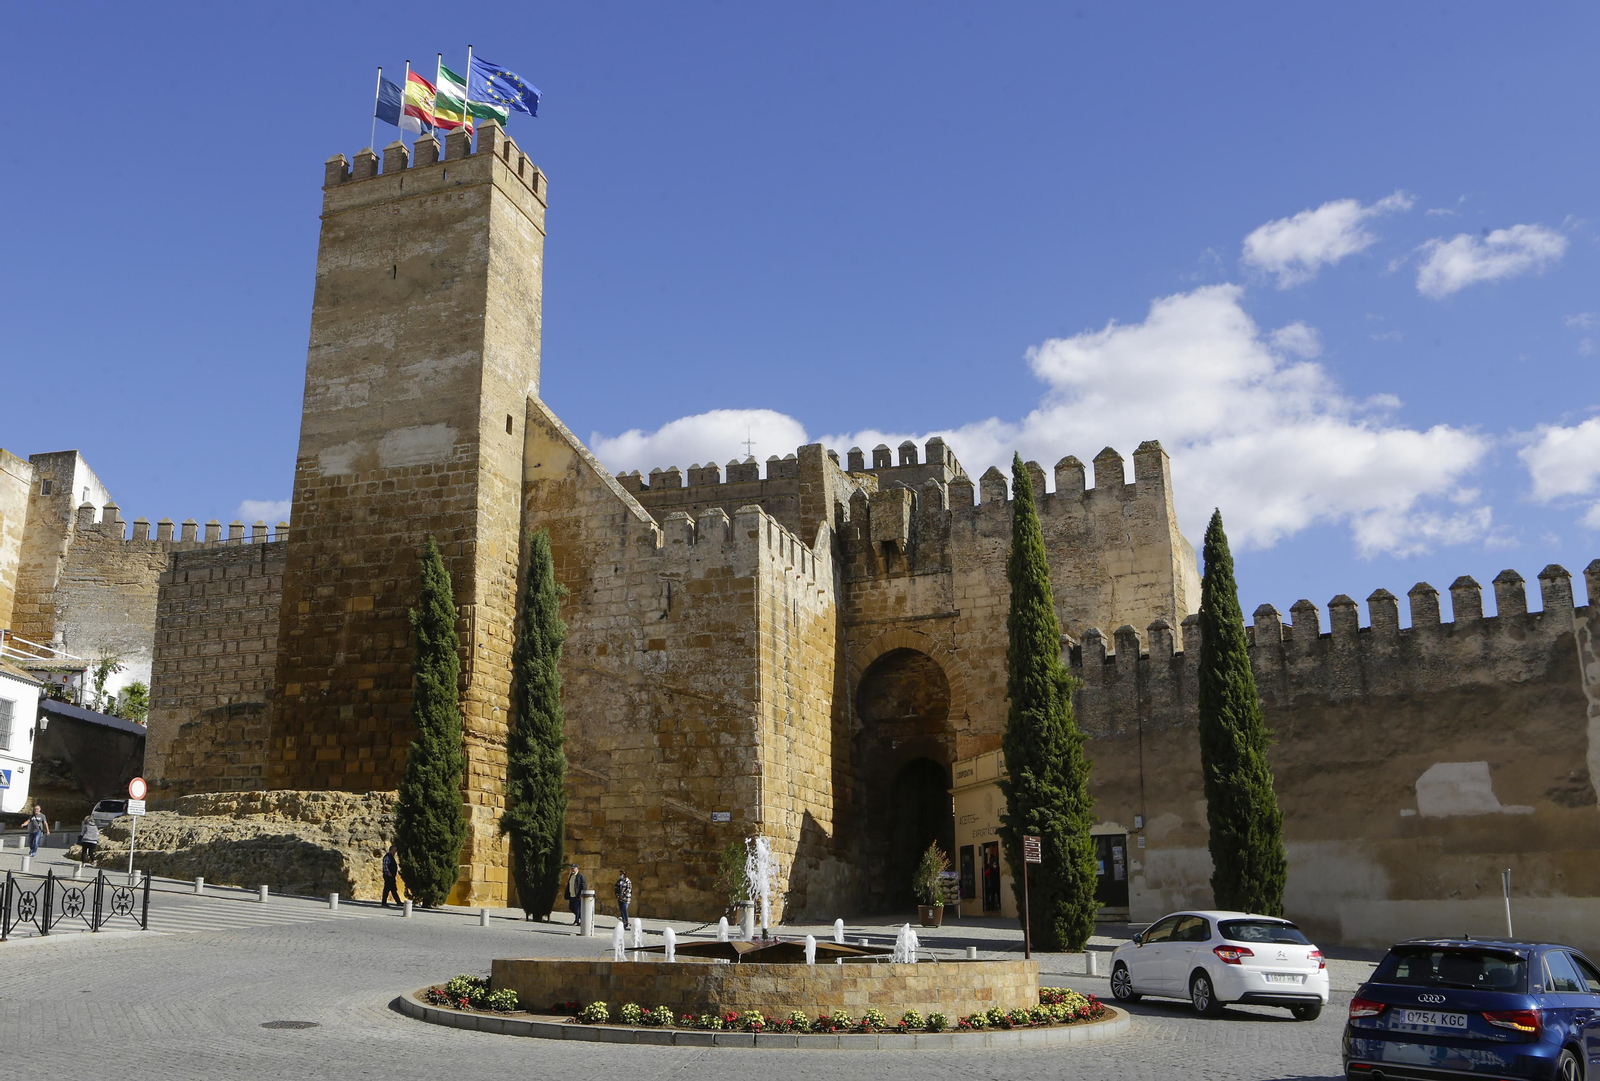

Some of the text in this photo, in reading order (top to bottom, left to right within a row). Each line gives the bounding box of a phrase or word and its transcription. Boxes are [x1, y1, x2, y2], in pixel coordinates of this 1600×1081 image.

[959, 814, 976, 825] ACEITES
[1407, 1011, 1465, 1027] 0754 KGC
